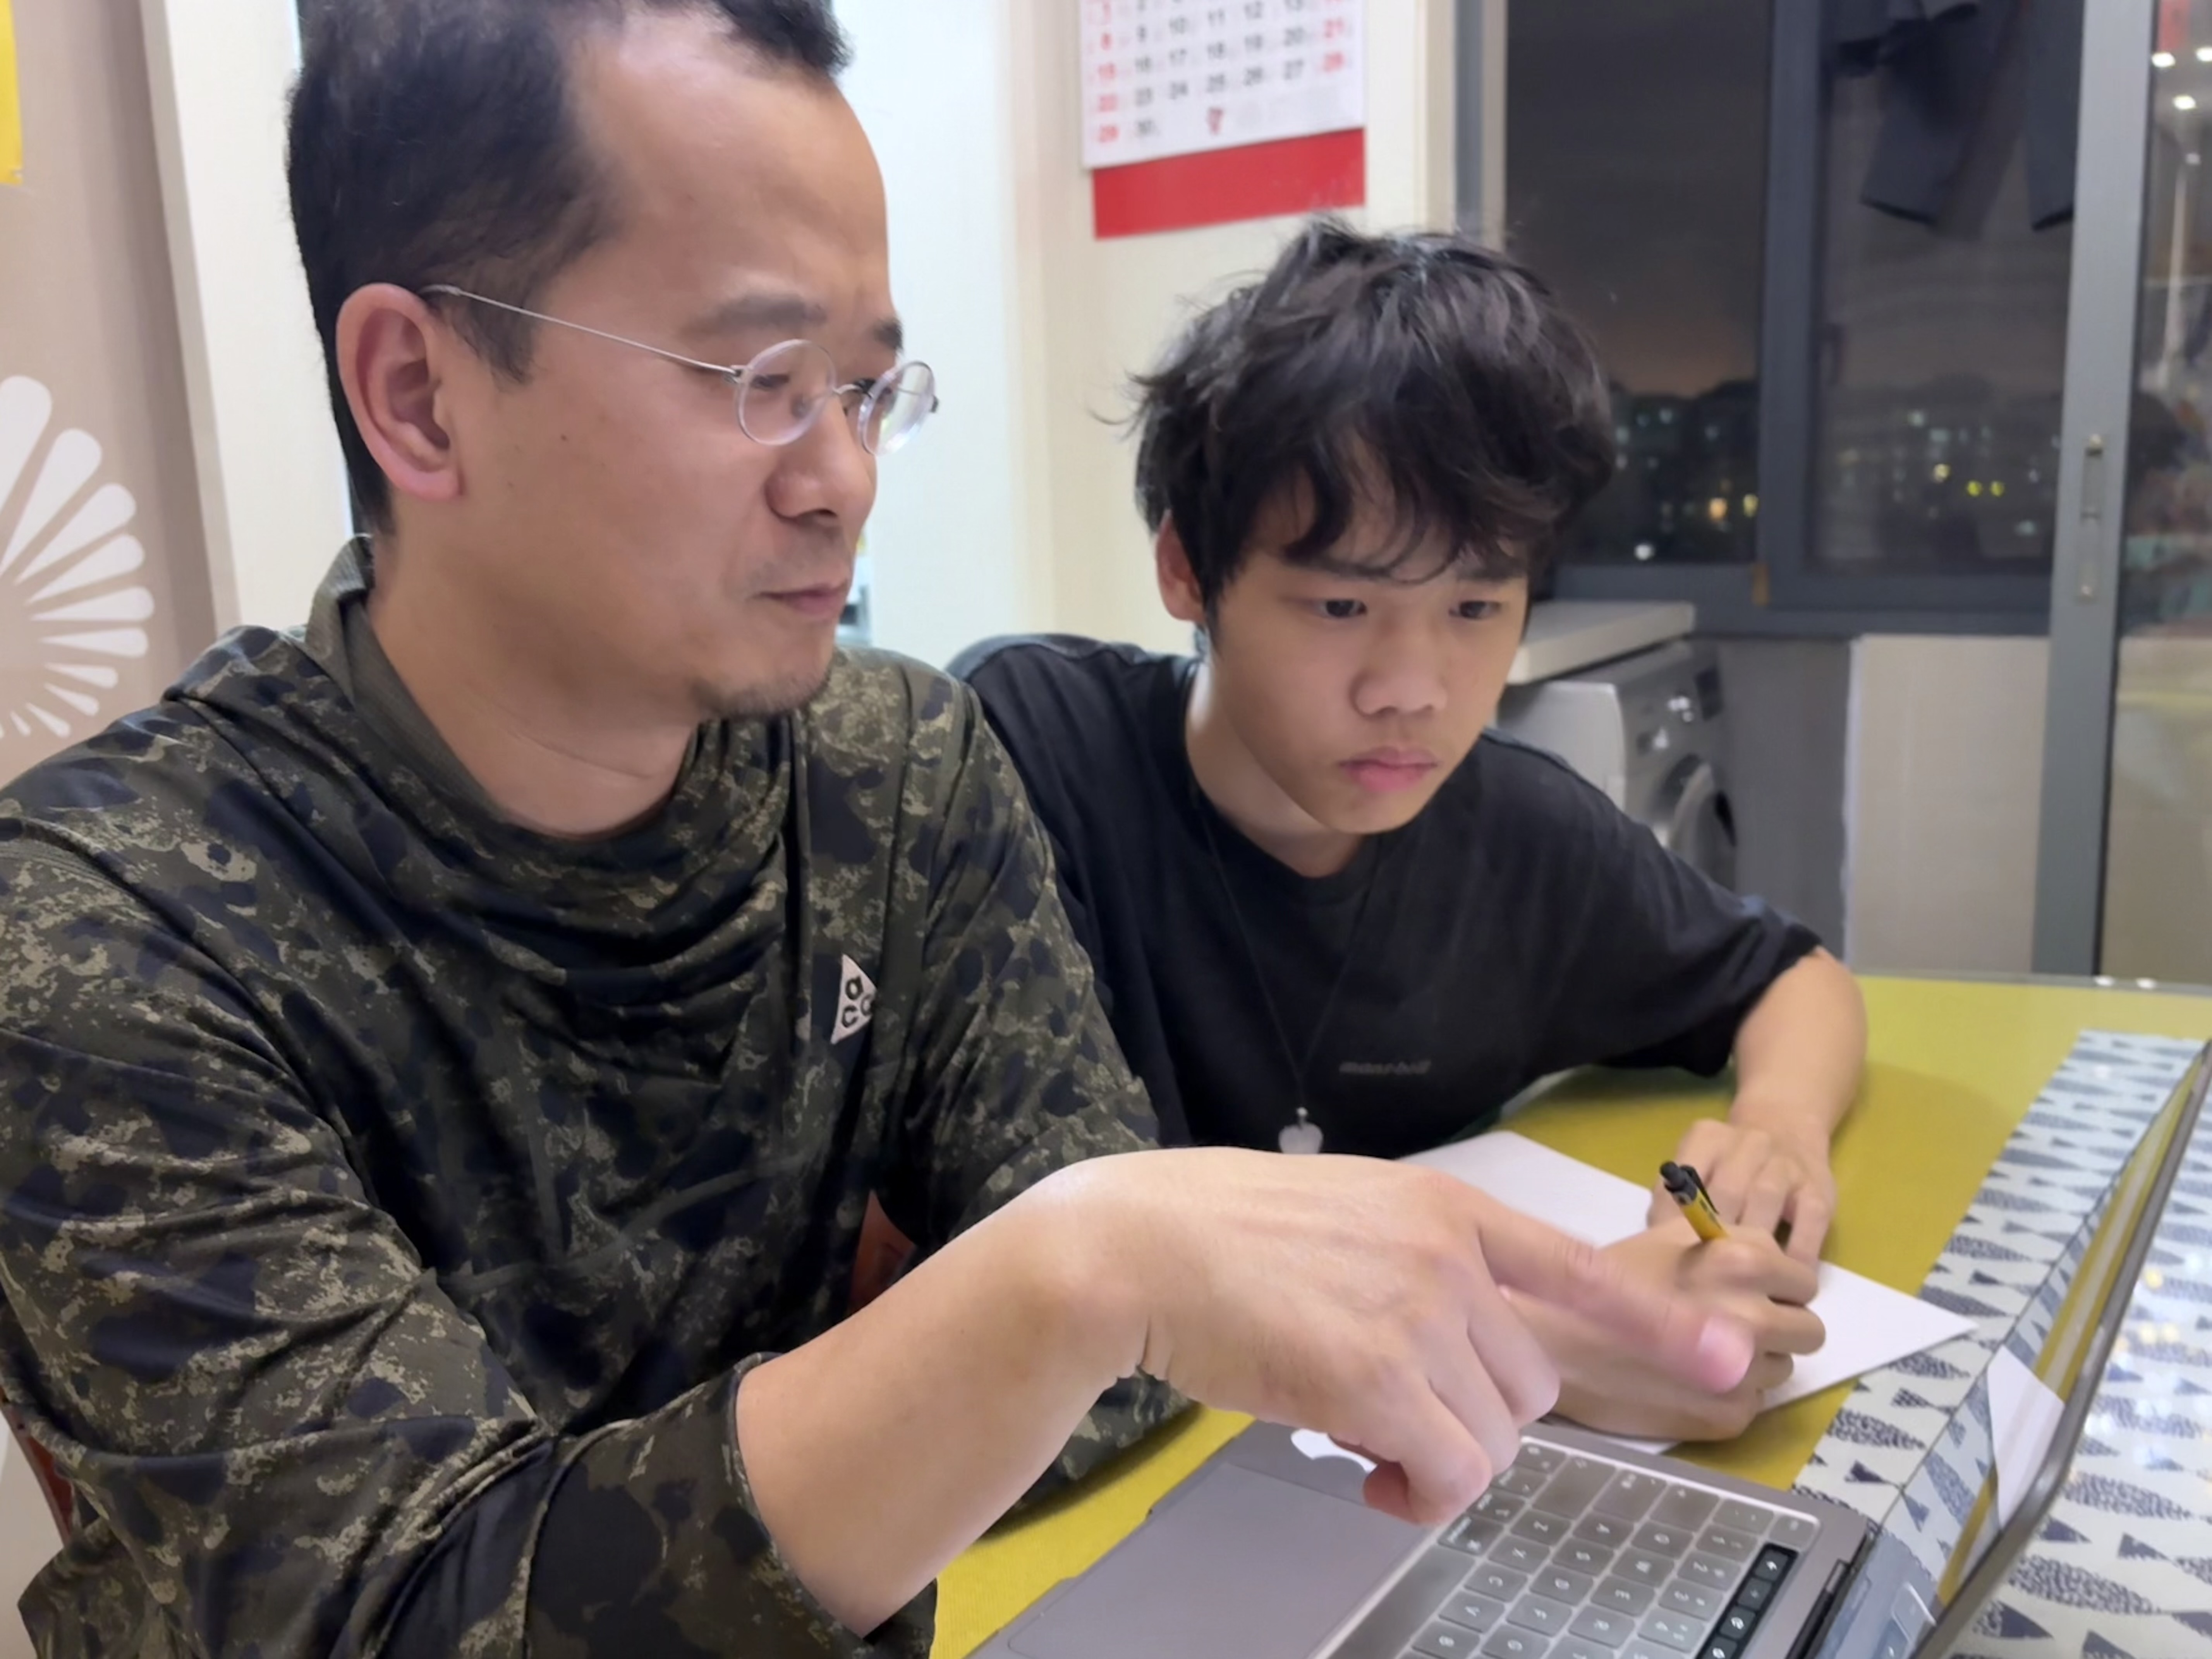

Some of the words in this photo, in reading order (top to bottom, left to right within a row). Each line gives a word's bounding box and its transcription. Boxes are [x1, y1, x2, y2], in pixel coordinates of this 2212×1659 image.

[1489, 1575, 1503, 1586] C
[1615, 1589, 1630, 1600] E
[1465, 1606, 1480, 1616] V
